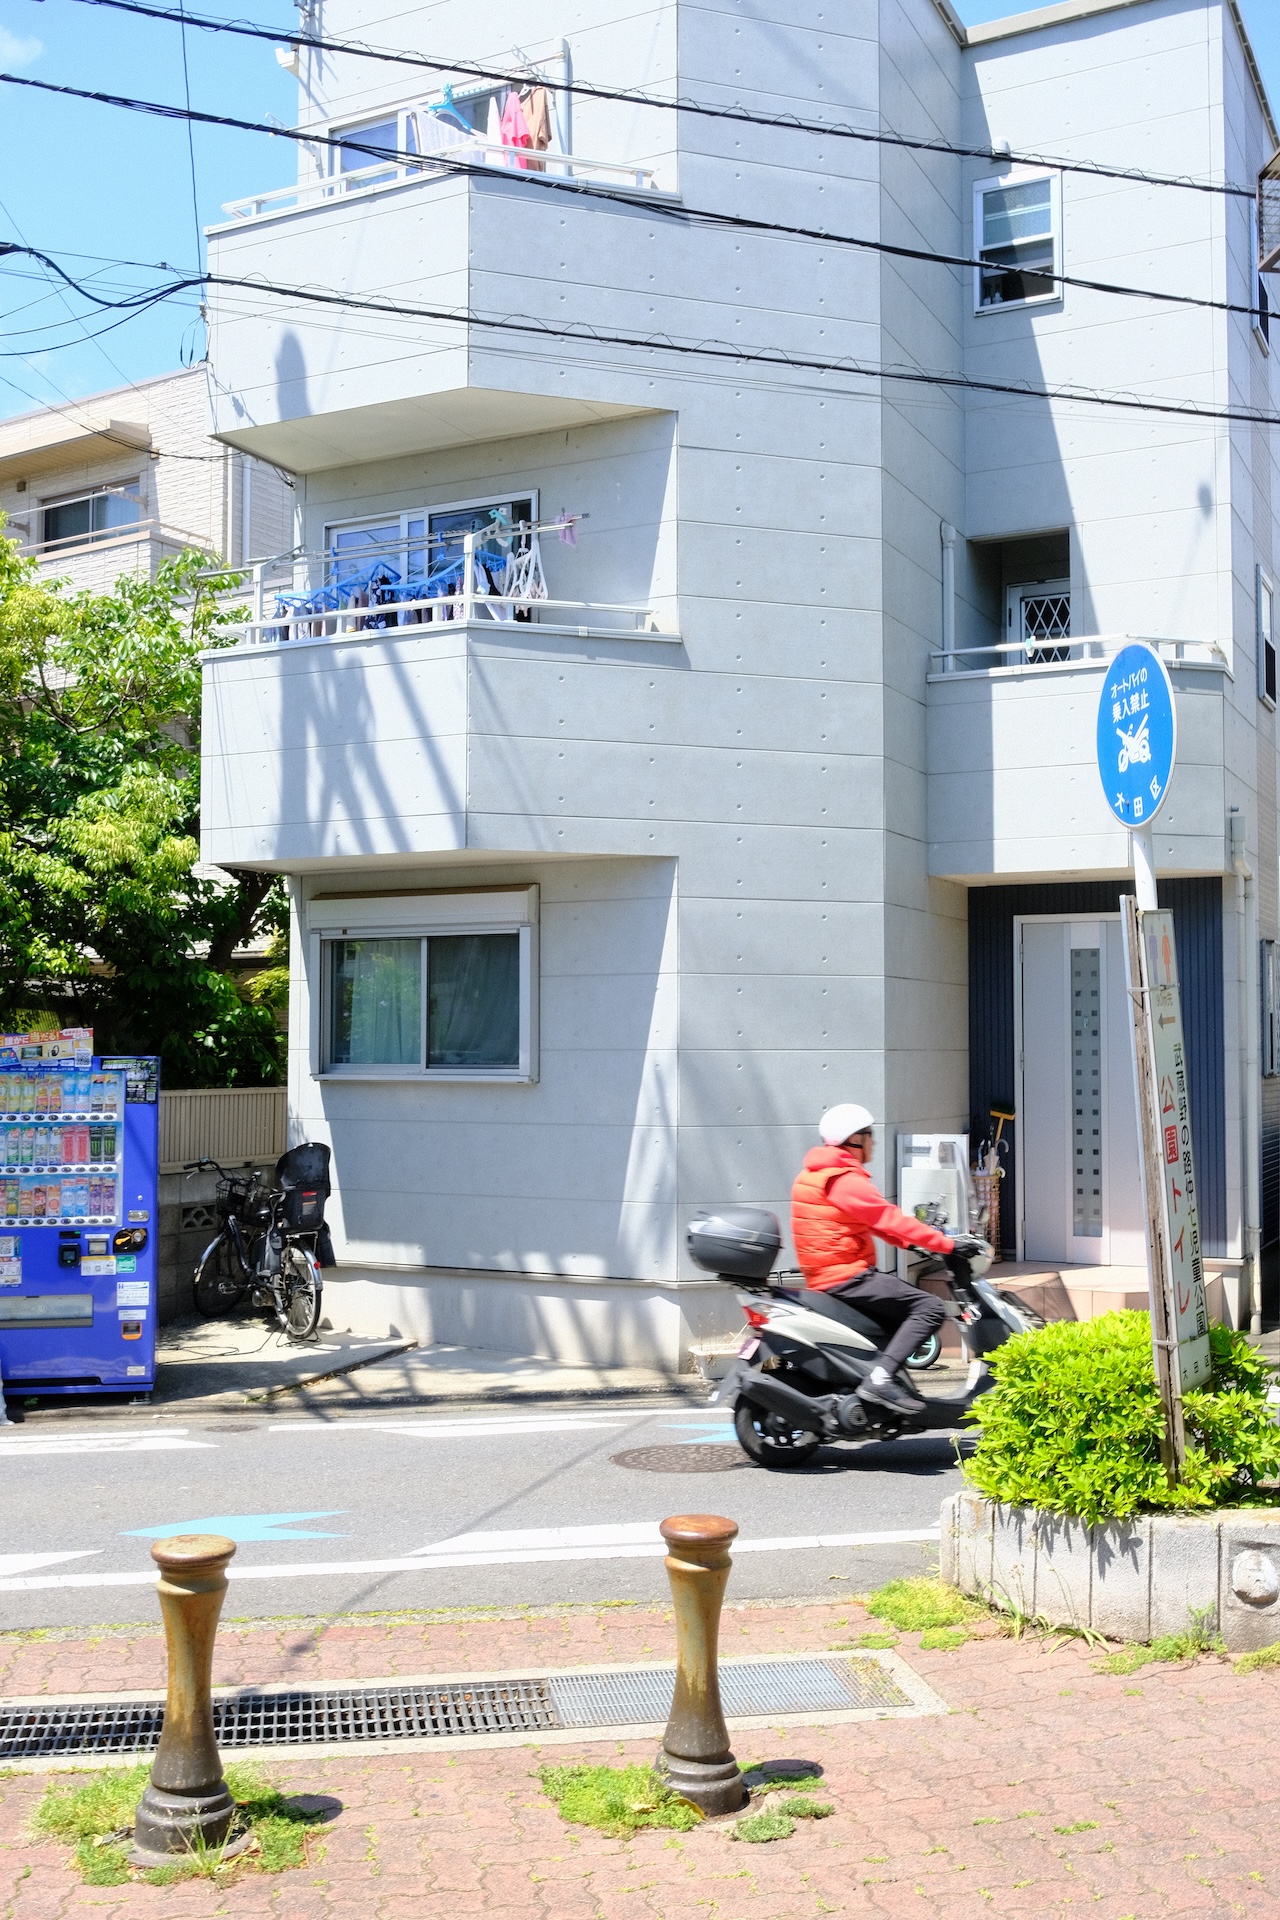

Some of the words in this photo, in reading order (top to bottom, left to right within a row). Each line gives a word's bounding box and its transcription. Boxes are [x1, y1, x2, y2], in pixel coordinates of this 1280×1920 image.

[1110, 667, 1148, 699] オートバイの
[1111, 687, 1150, 723] 乗入禁止
[1114, 774, 1162, 818] 大田区
[1160, 1075, 1191, 1316] 公園トイレ
[1182, 1354, 1210, 1381] 大田区
